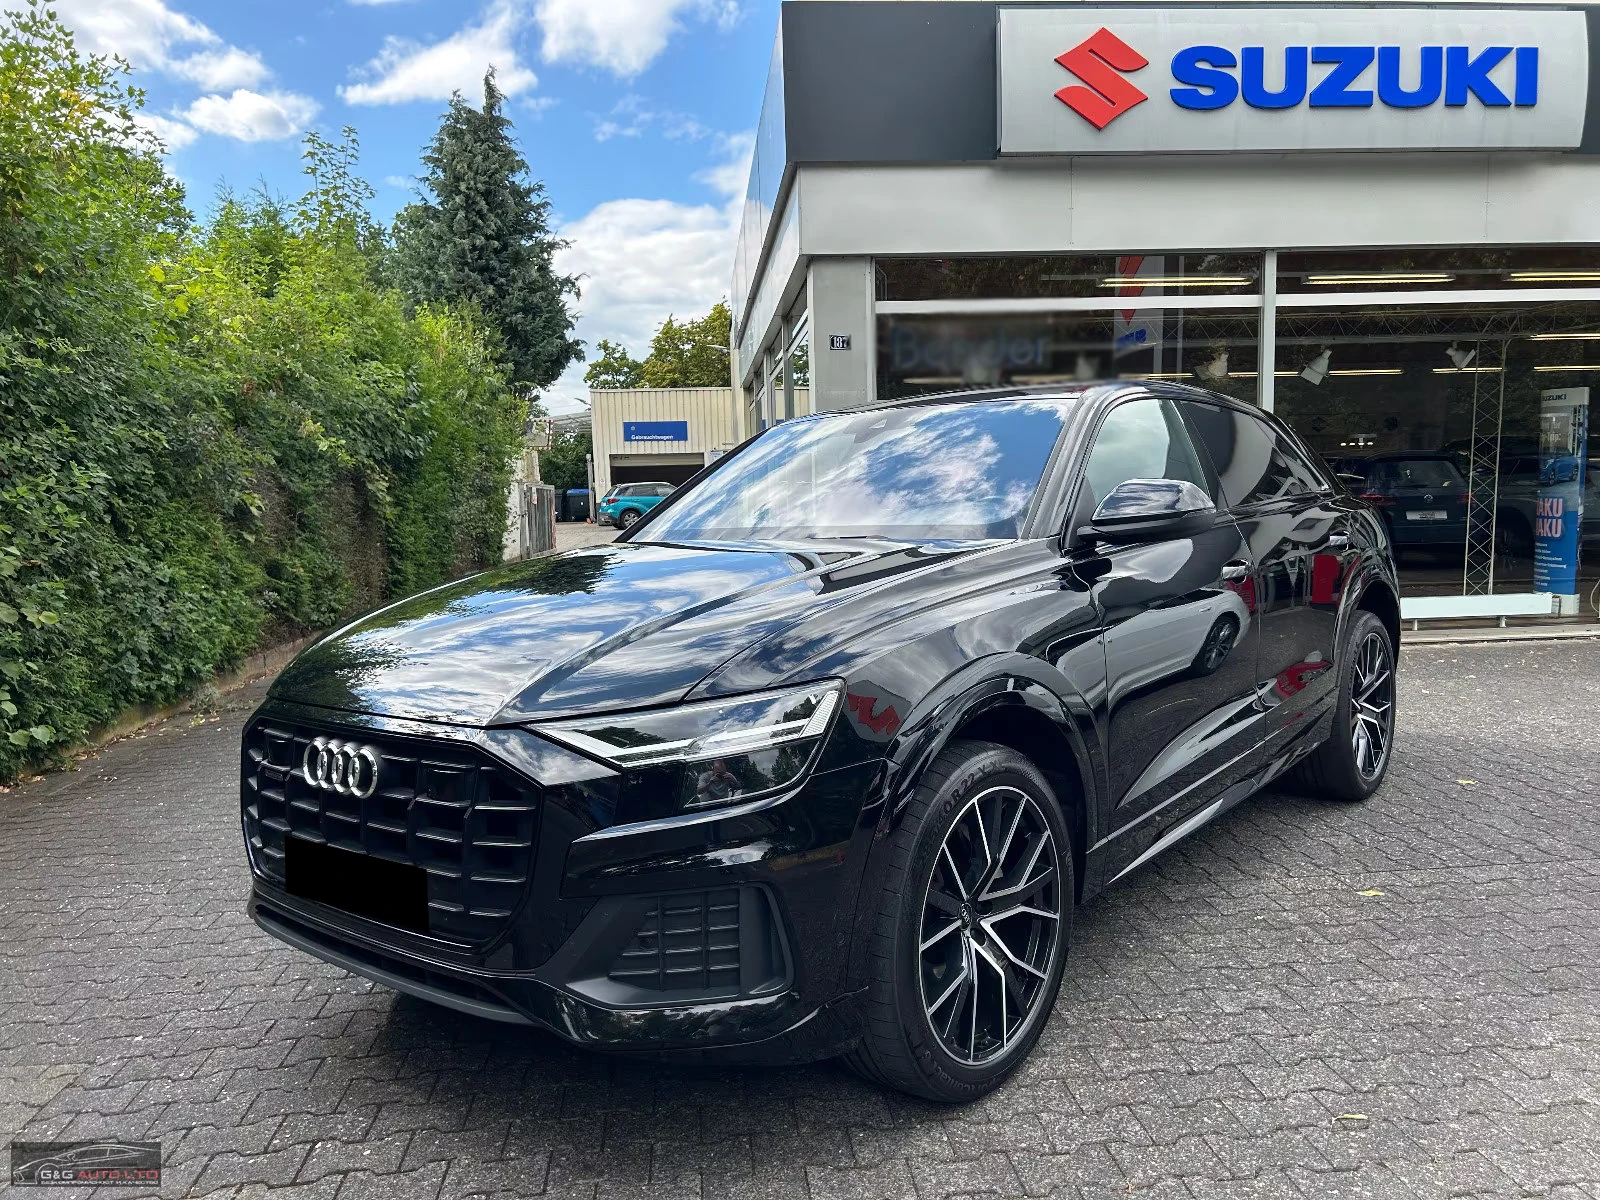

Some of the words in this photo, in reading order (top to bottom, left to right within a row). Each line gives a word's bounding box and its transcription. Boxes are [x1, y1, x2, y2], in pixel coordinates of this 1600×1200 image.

[1170, 45, 1539, 110] SUZUKI
[1536, 498, 1563, 517] AKU
[1536, 518, 1562, 538] AKU
